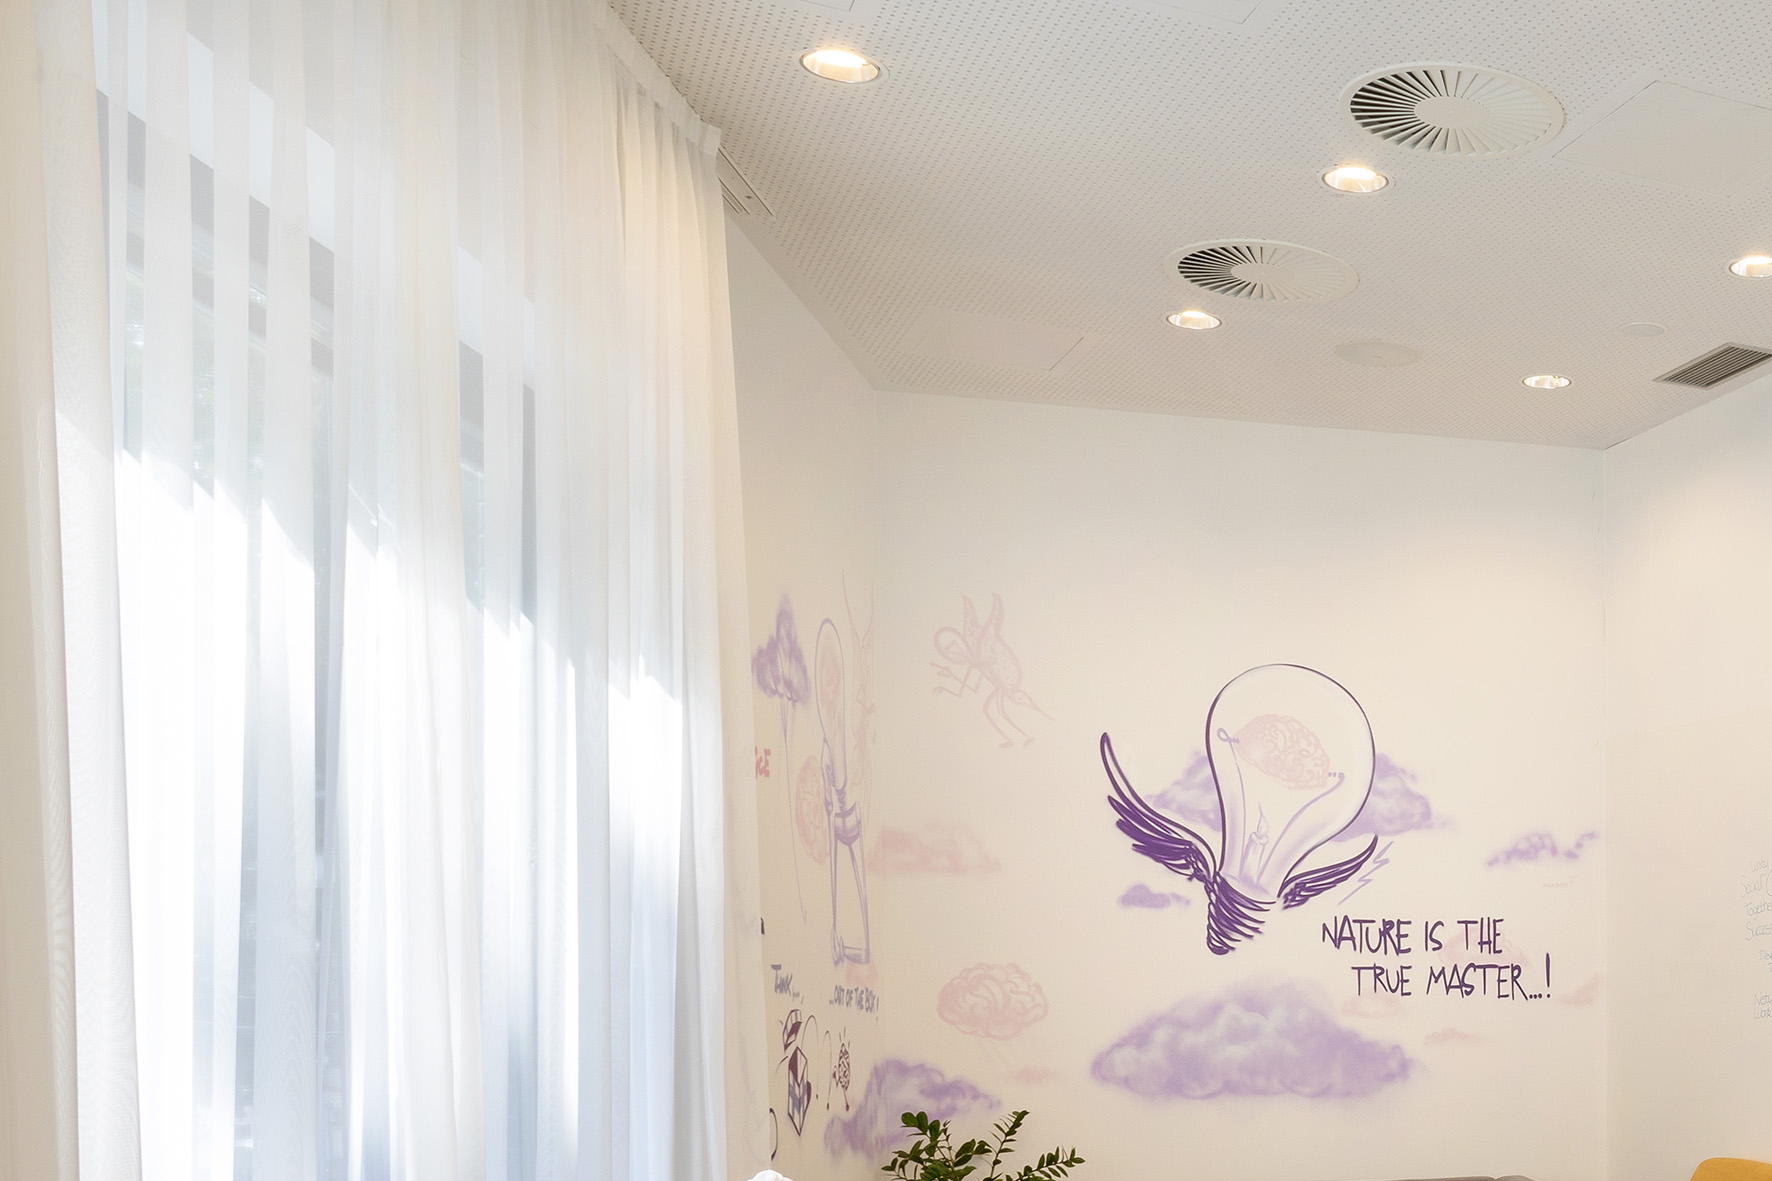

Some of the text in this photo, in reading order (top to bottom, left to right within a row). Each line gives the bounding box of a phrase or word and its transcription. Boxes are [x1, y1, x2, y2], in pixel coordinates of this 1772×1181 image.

[1321, 914, 1506, 957] NATURE IS THE
[845, 988, 854, 1007] OF
[1351, 963, 1413, 998] TRUE
